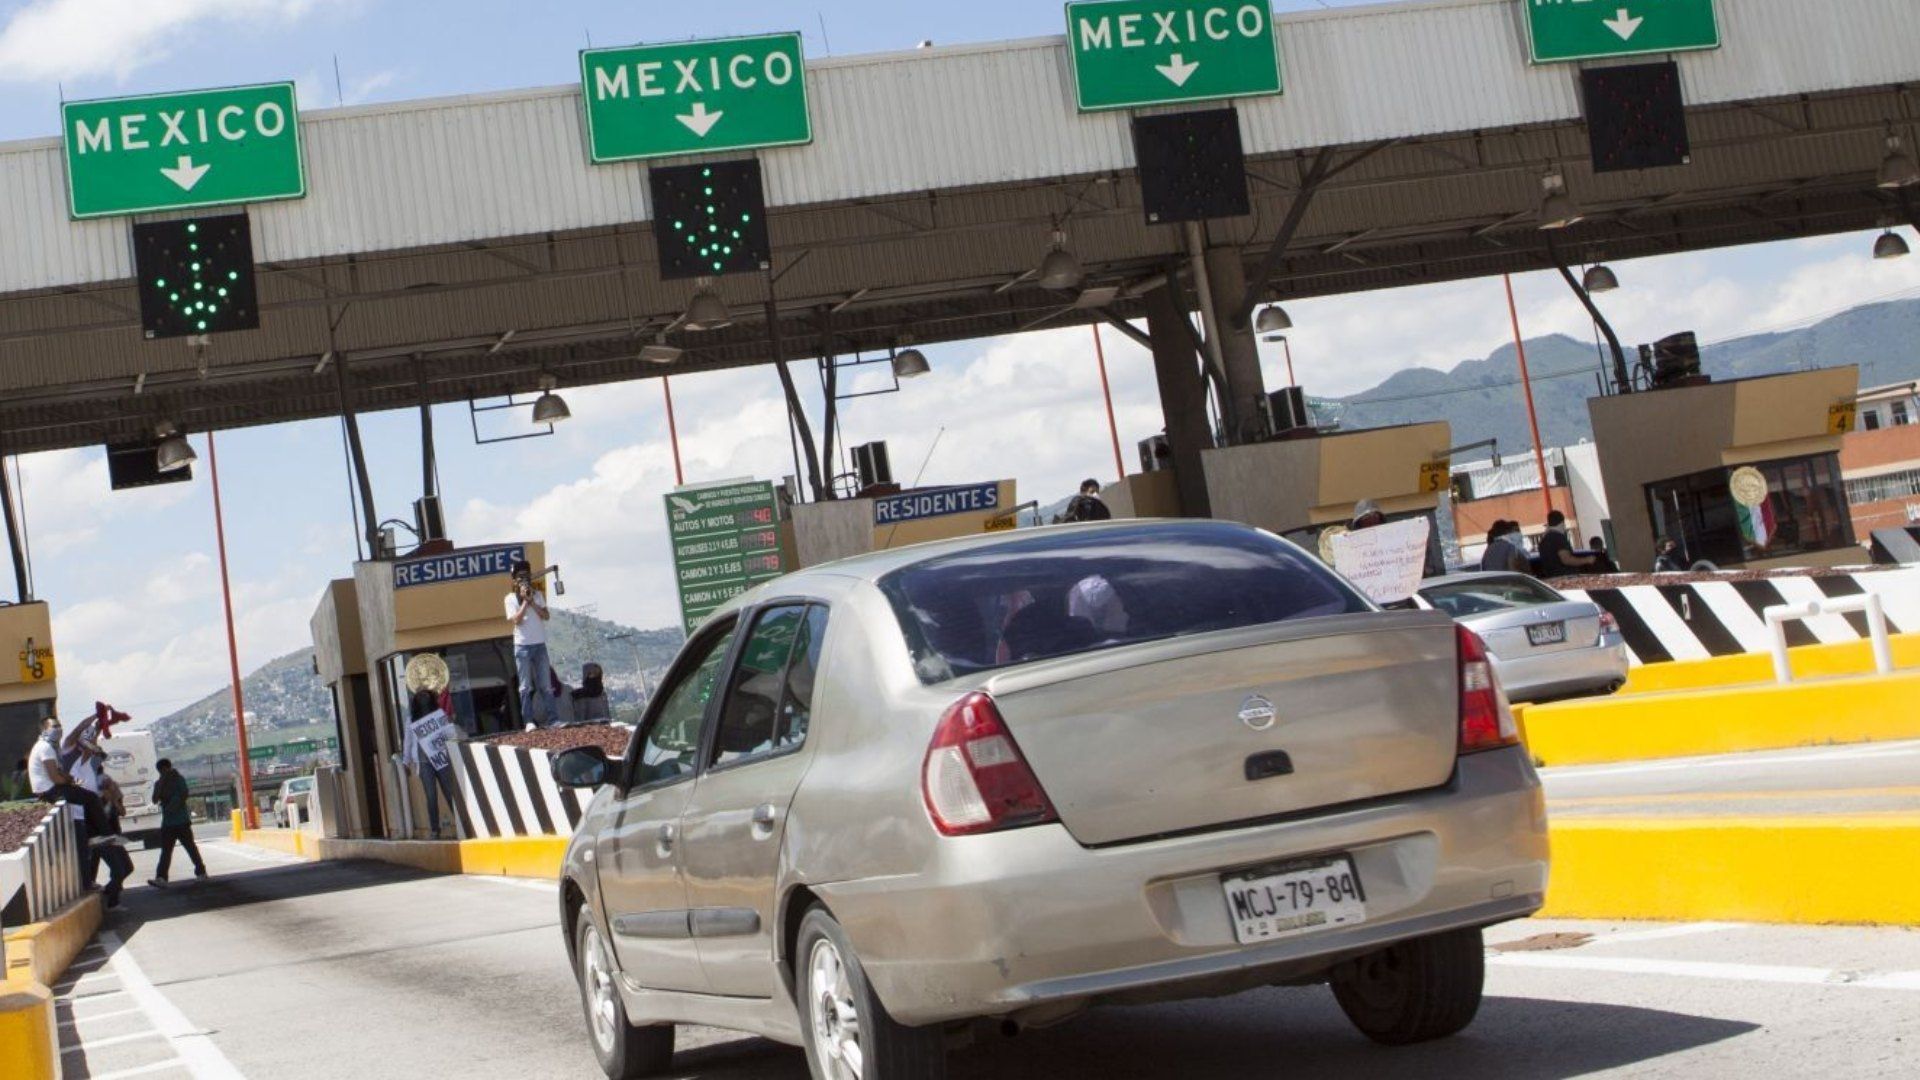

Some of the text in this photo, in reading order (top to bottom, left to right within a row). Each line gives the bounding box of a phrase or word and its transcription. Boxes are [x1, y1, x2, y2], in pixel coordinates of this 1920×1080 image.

[1079, 5, 1263, 50] MEXICO
[594, 51, 793, 100] MEXICO
[75, 102, 285, 154] MEXICO
[1837, 415, 1847, 434] 4
[1429, 473, 1439, 491] 5
[876, 487, 997, 521] RESIDENTES
[674, 515, 735, 532] AUTOS Y MOTOS
[396, 549, 522, 586] RESIDENTES
[681, 567, 707, 579] CAMION
[724, 561, 742, 573] EJES
[684, 592, 711, 604] CAMION
[32, 662, 44, 679] 8
[1231, 872, 1357, 921] MCJ-79-84
